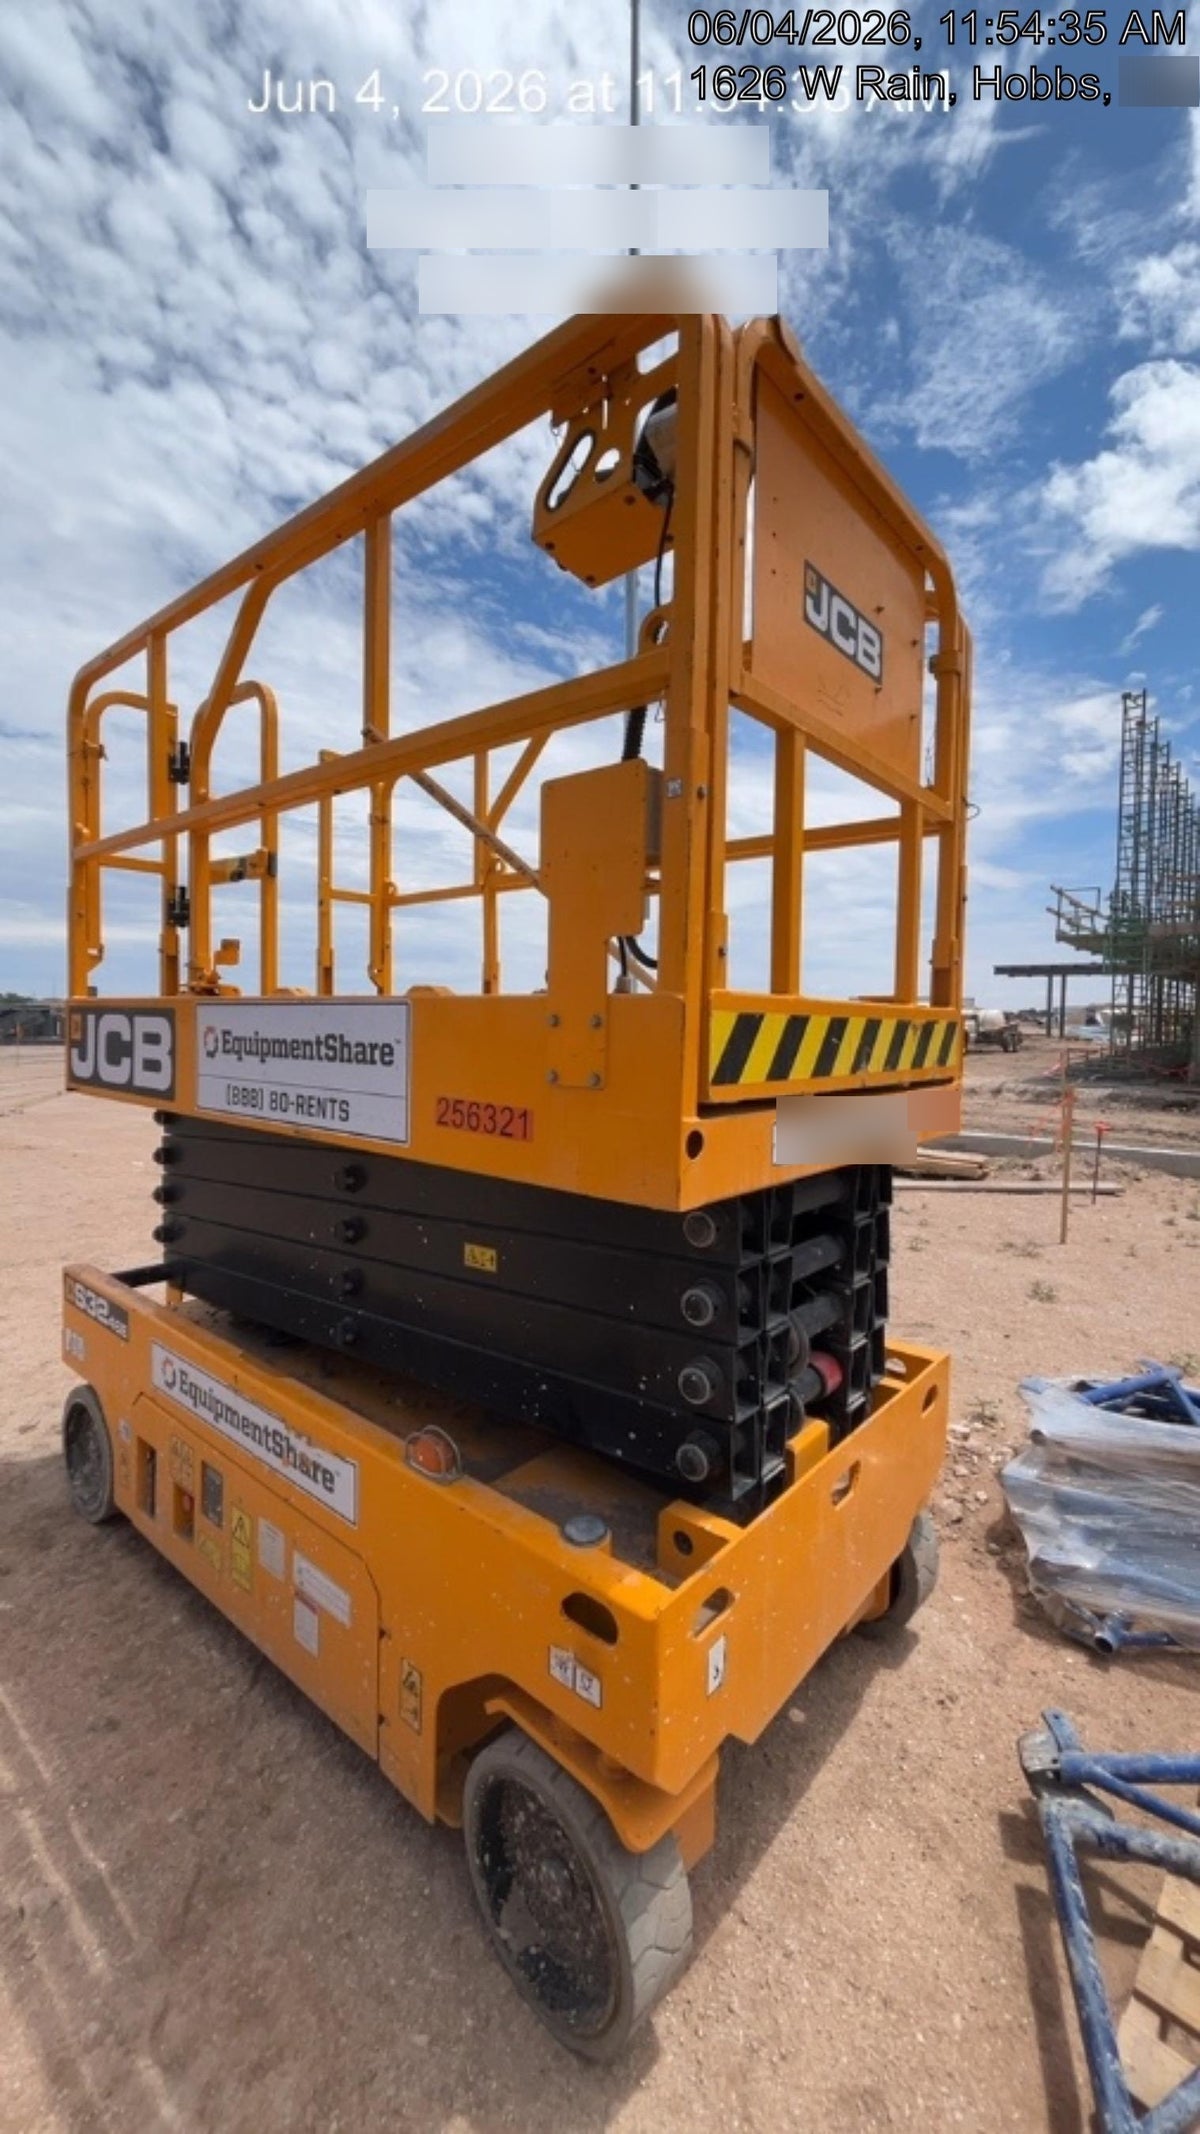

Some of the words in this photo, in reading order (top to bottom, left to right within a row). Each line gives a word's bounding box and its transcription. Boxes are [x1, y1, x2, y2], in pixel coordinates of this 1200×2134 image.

[805, 580, 881, 677] JCB
[71, 1013, 172, 1092] JCB
[220, 1029, 395, 1067] EquipmentShare
[269, 1090, 350, 1123] 80-RENTS
[436, 1097, 529, 1140] 256321
[178, 1369, 336, 1494] EquipmentShare
